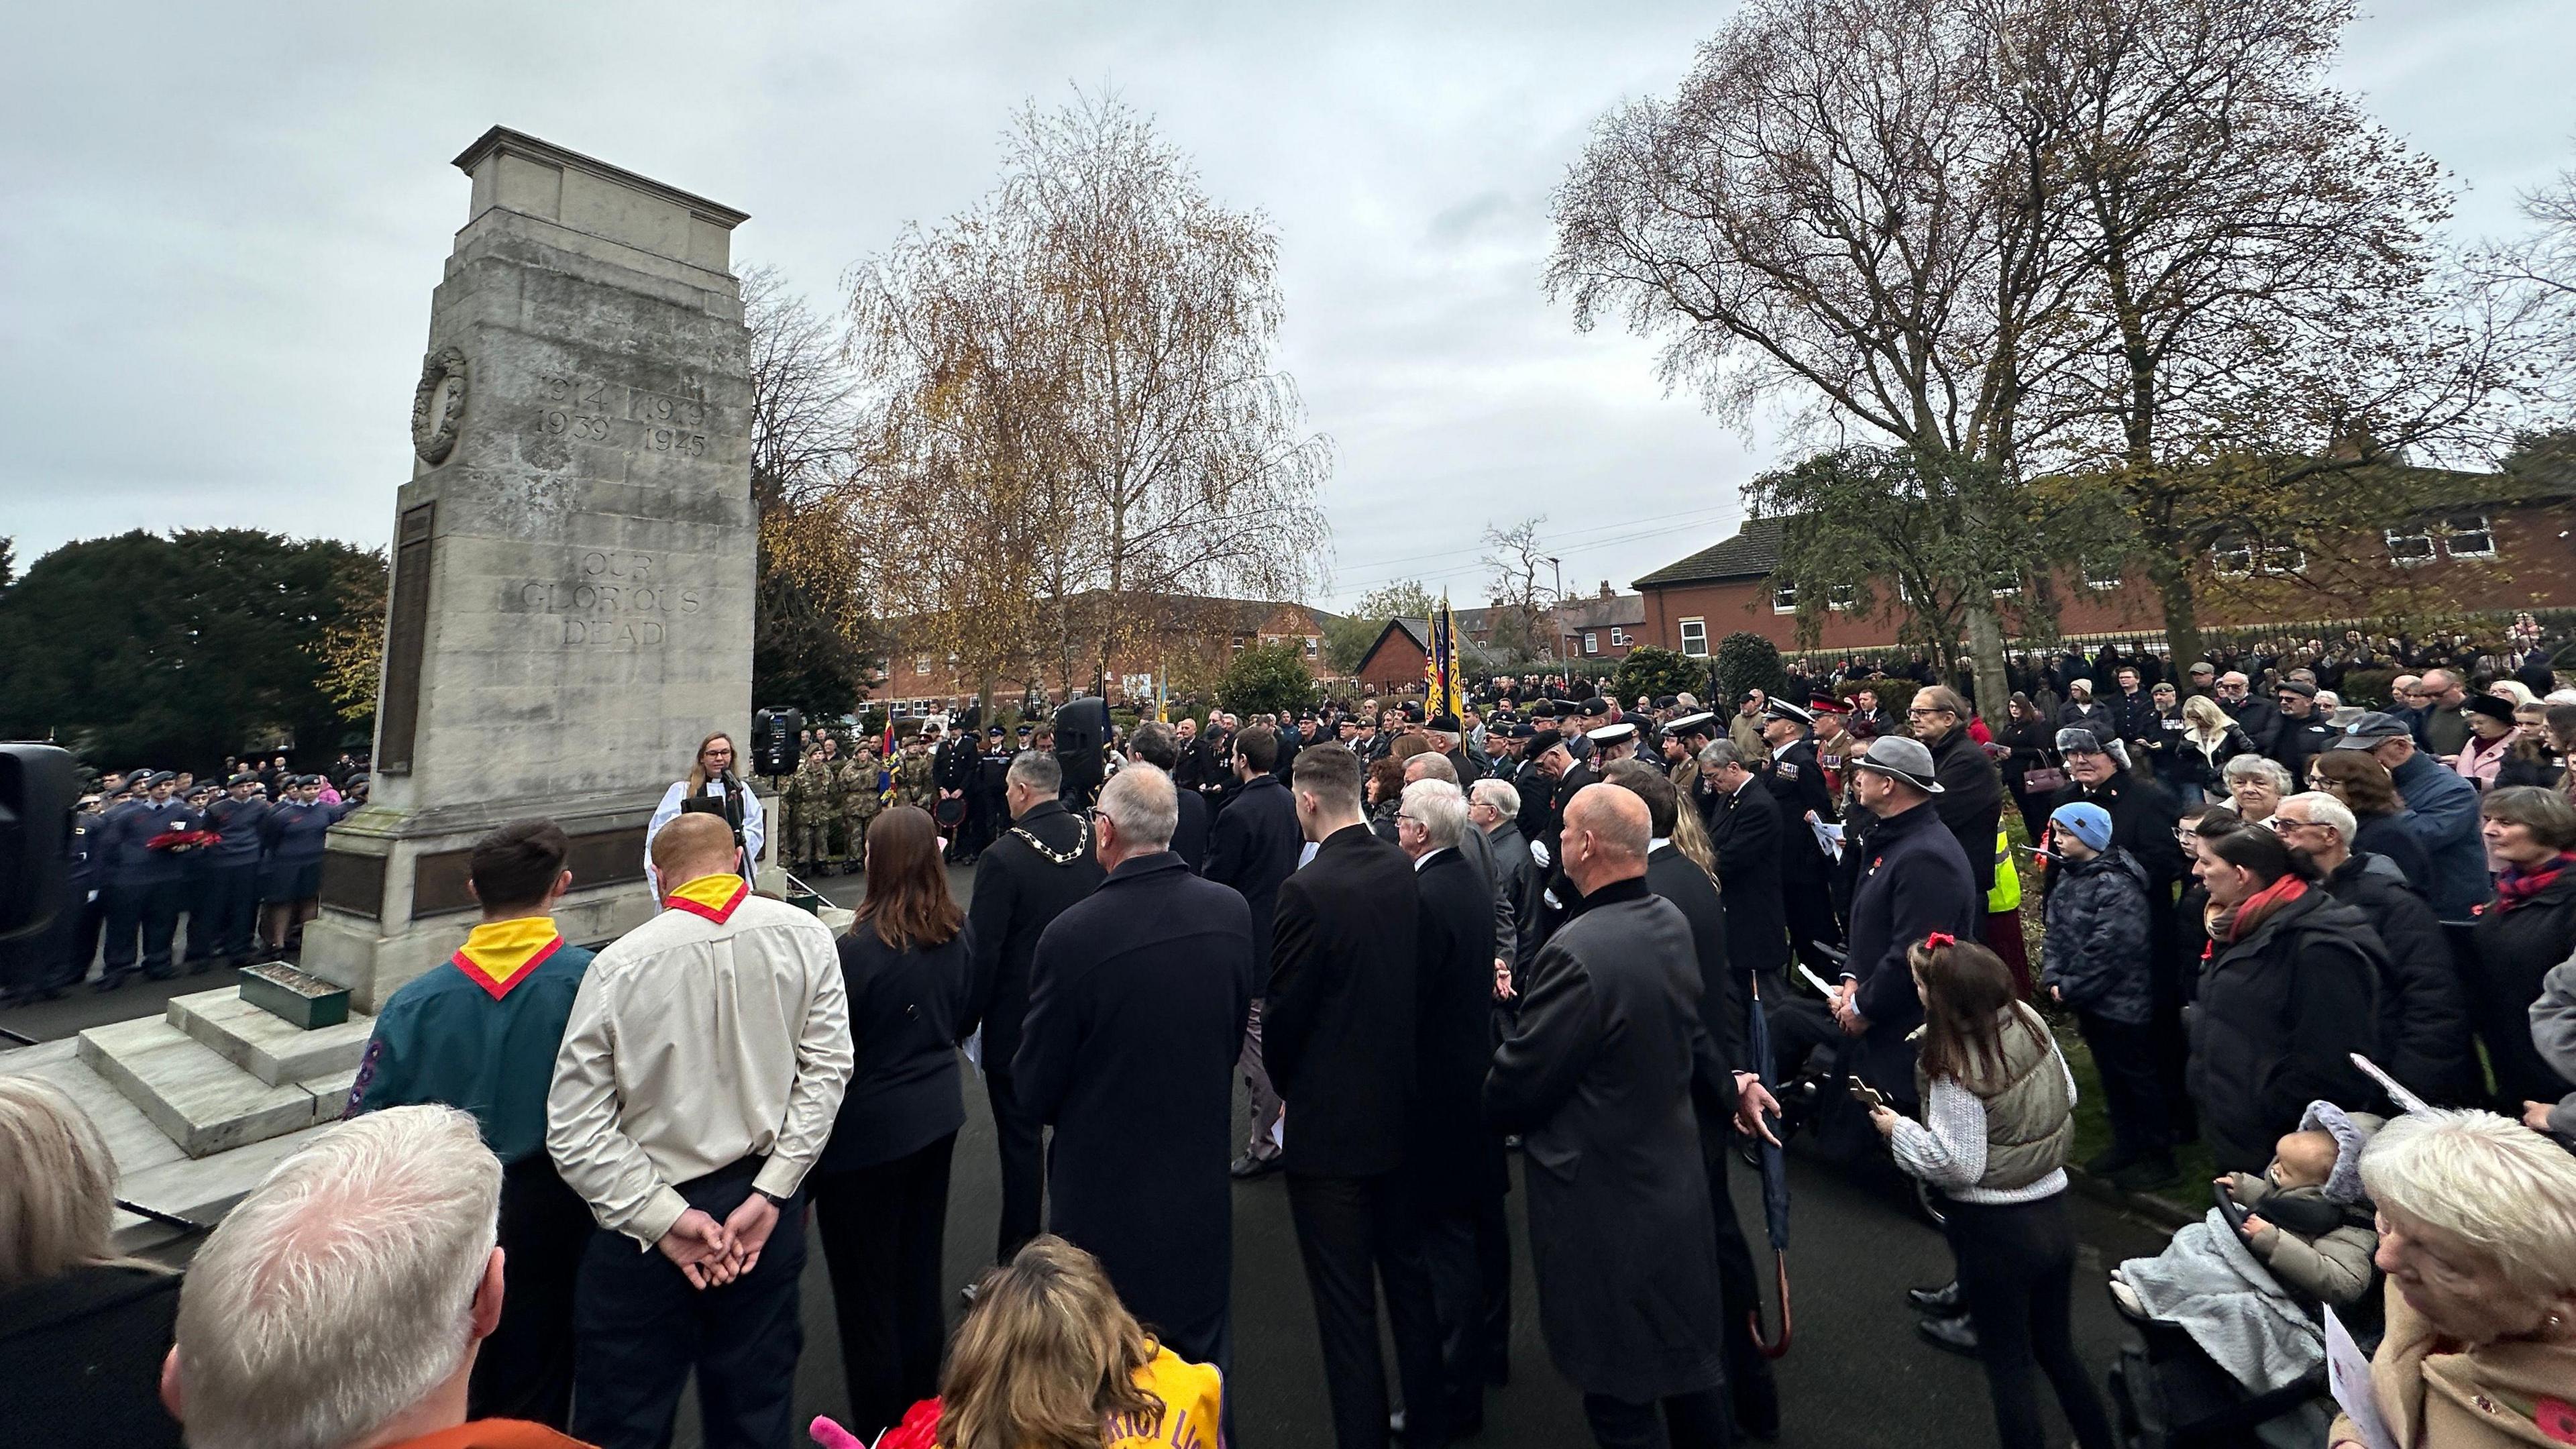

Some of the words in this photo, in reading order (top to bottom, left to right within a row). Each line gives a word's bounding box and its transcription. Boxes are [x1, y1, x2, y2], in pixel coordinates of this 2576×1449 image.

[539, 376, 608, 411] 1914
[537, 410, 609, 441] 1939
[645, 428, 705, 457] 1945
[584, 552, 653, 580] OUR
[521, 582, 699, 613] GLORIOUS
[564, 620, 663, 645] DEAD
[1106, 1402, 1166, 1444] RICT
